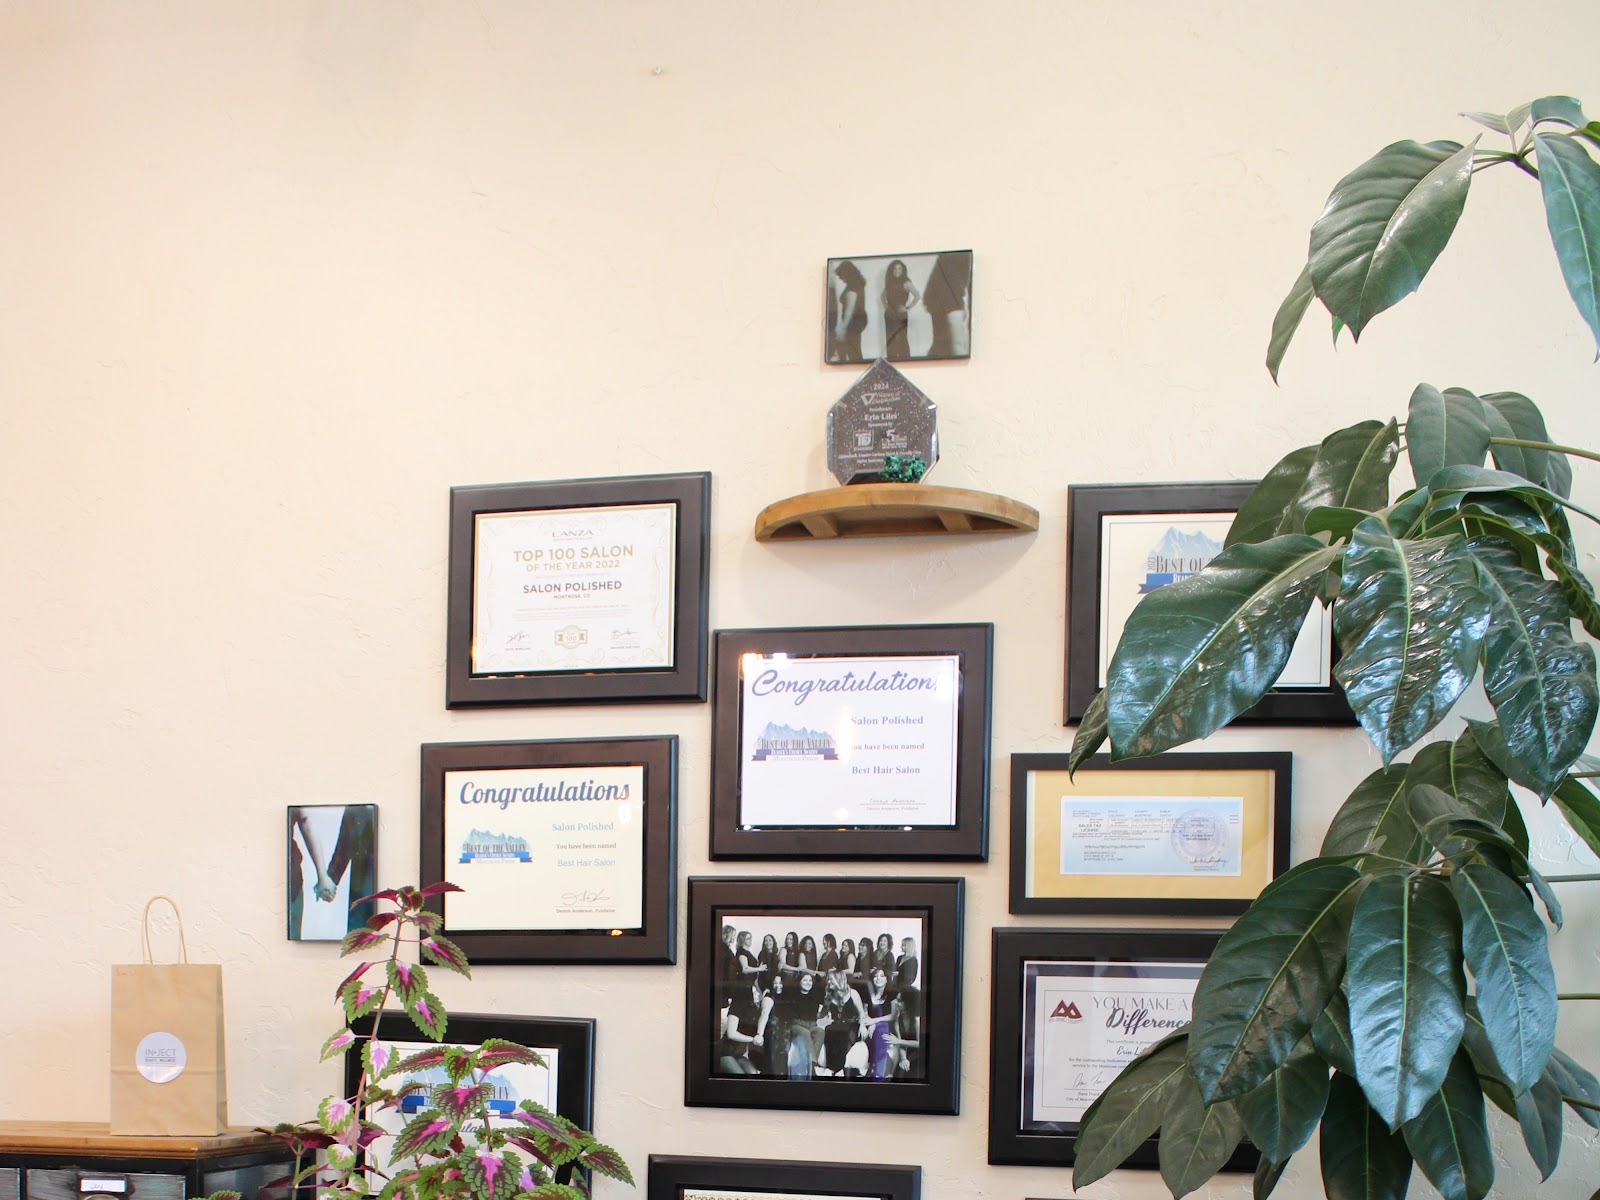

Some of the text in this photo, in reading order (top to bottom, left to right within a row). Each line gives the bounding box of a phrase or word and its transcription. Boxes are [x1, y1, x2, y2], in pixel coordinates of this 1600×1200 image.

[513, 544, 634, 562] TOP 100 SALON
[526, 560, 620, 572] OF THE YEAR 2022
[1156, 555, 1186, 573] BEST
[523, 580, 622, 594] SALON POLISHED
[882, 715, 924, 726] Polished
[900, 742, 925, 750] named
[851, 765, 920, 775] Best Hair Salon
[460, 779, 630, 811] Congratulations
[552, 822, 614, 832] Salon Polished
[583, 842, 596, 850] been
[557, 858, 616, 867] Best Hair Salon
[1093, 996, 1188, 1011] YOU MAKE A
[1116, 1046, 1132, 1055] Erin
